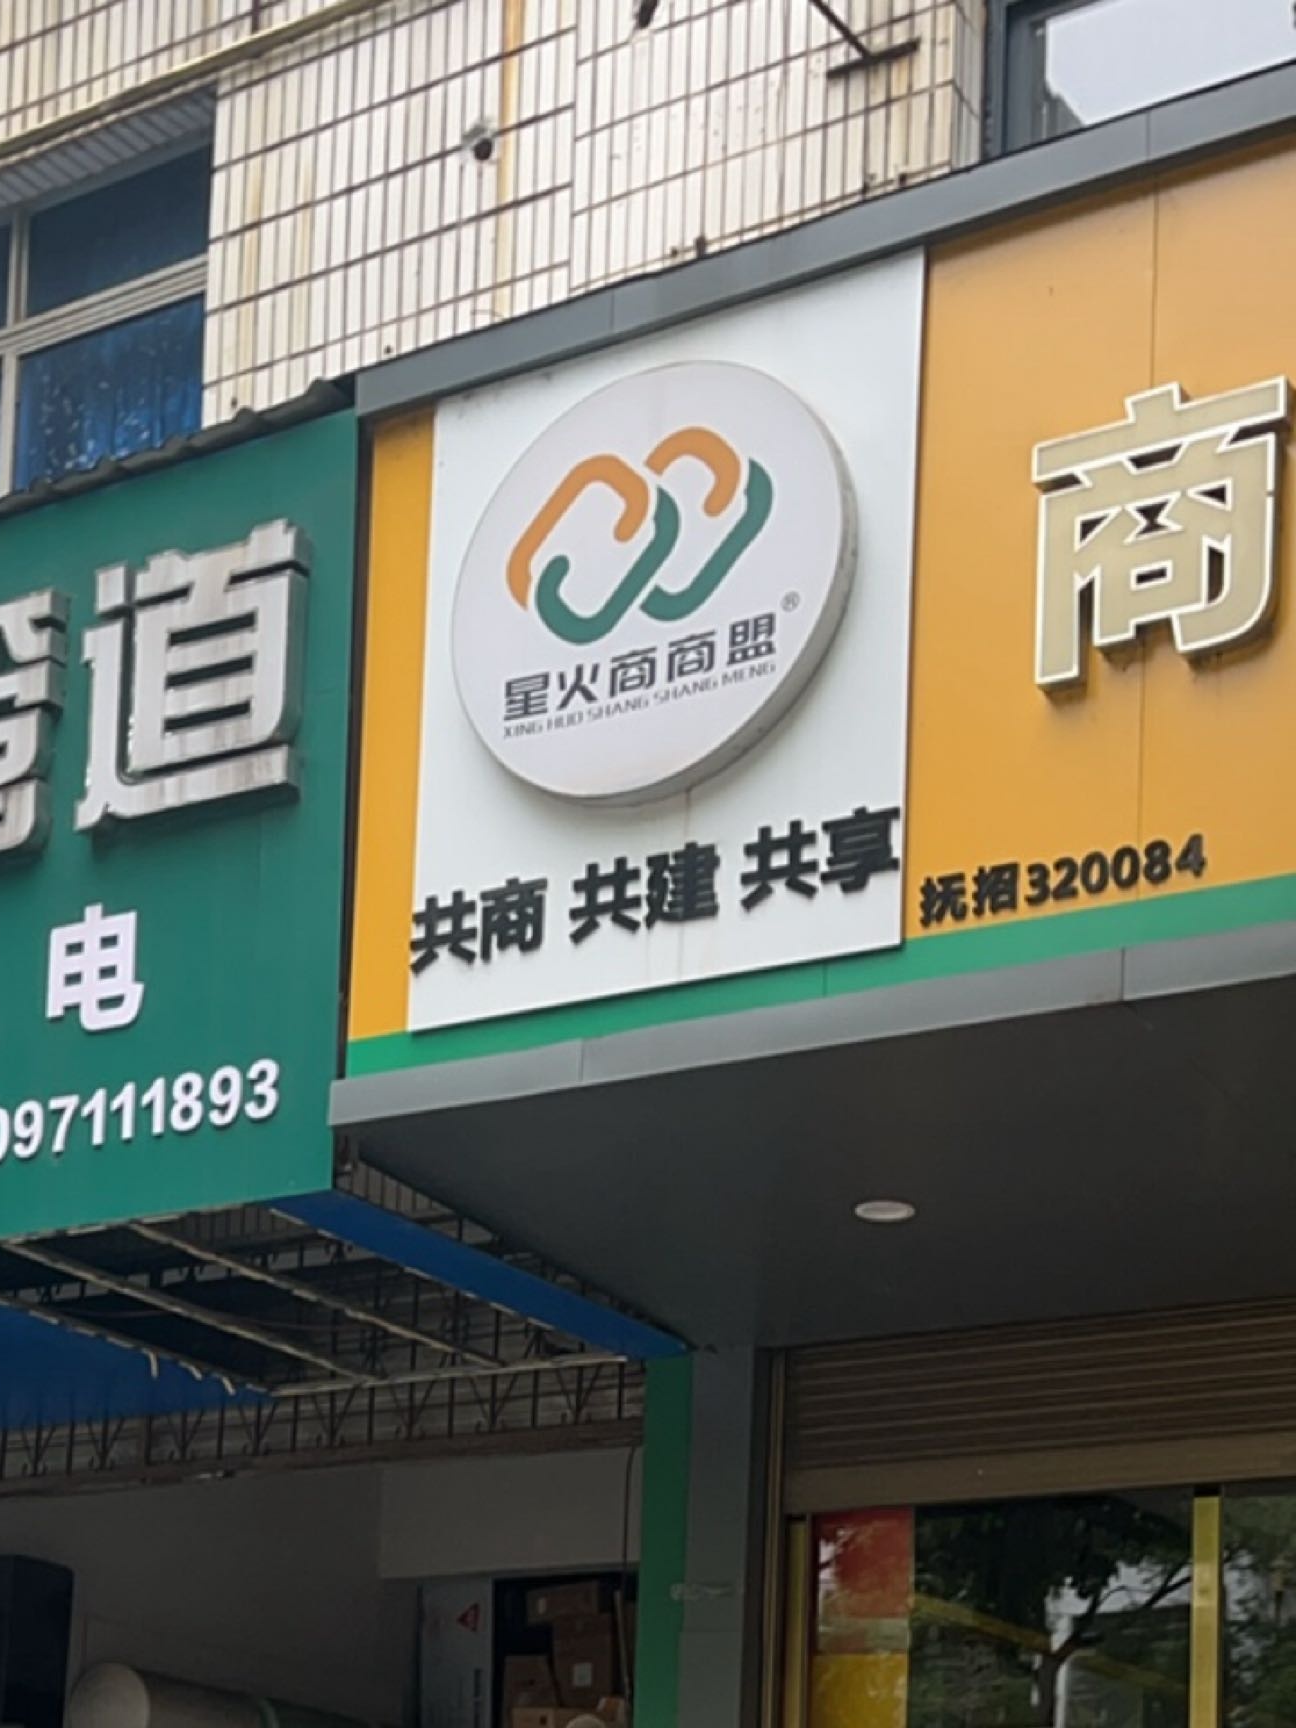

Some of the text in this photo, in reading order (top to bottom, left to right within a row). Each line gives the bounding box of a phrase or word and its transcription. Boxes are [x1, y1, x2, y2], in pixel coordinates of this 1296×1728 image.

[1032, 374, 1290, 686] 商
[503, 612, 777, 722] 星火商商盟
[503, 662, 777, 740] XING HUO SHANG SHANG MENG
[408, 805, 902, 975] 共商 共建 共享
